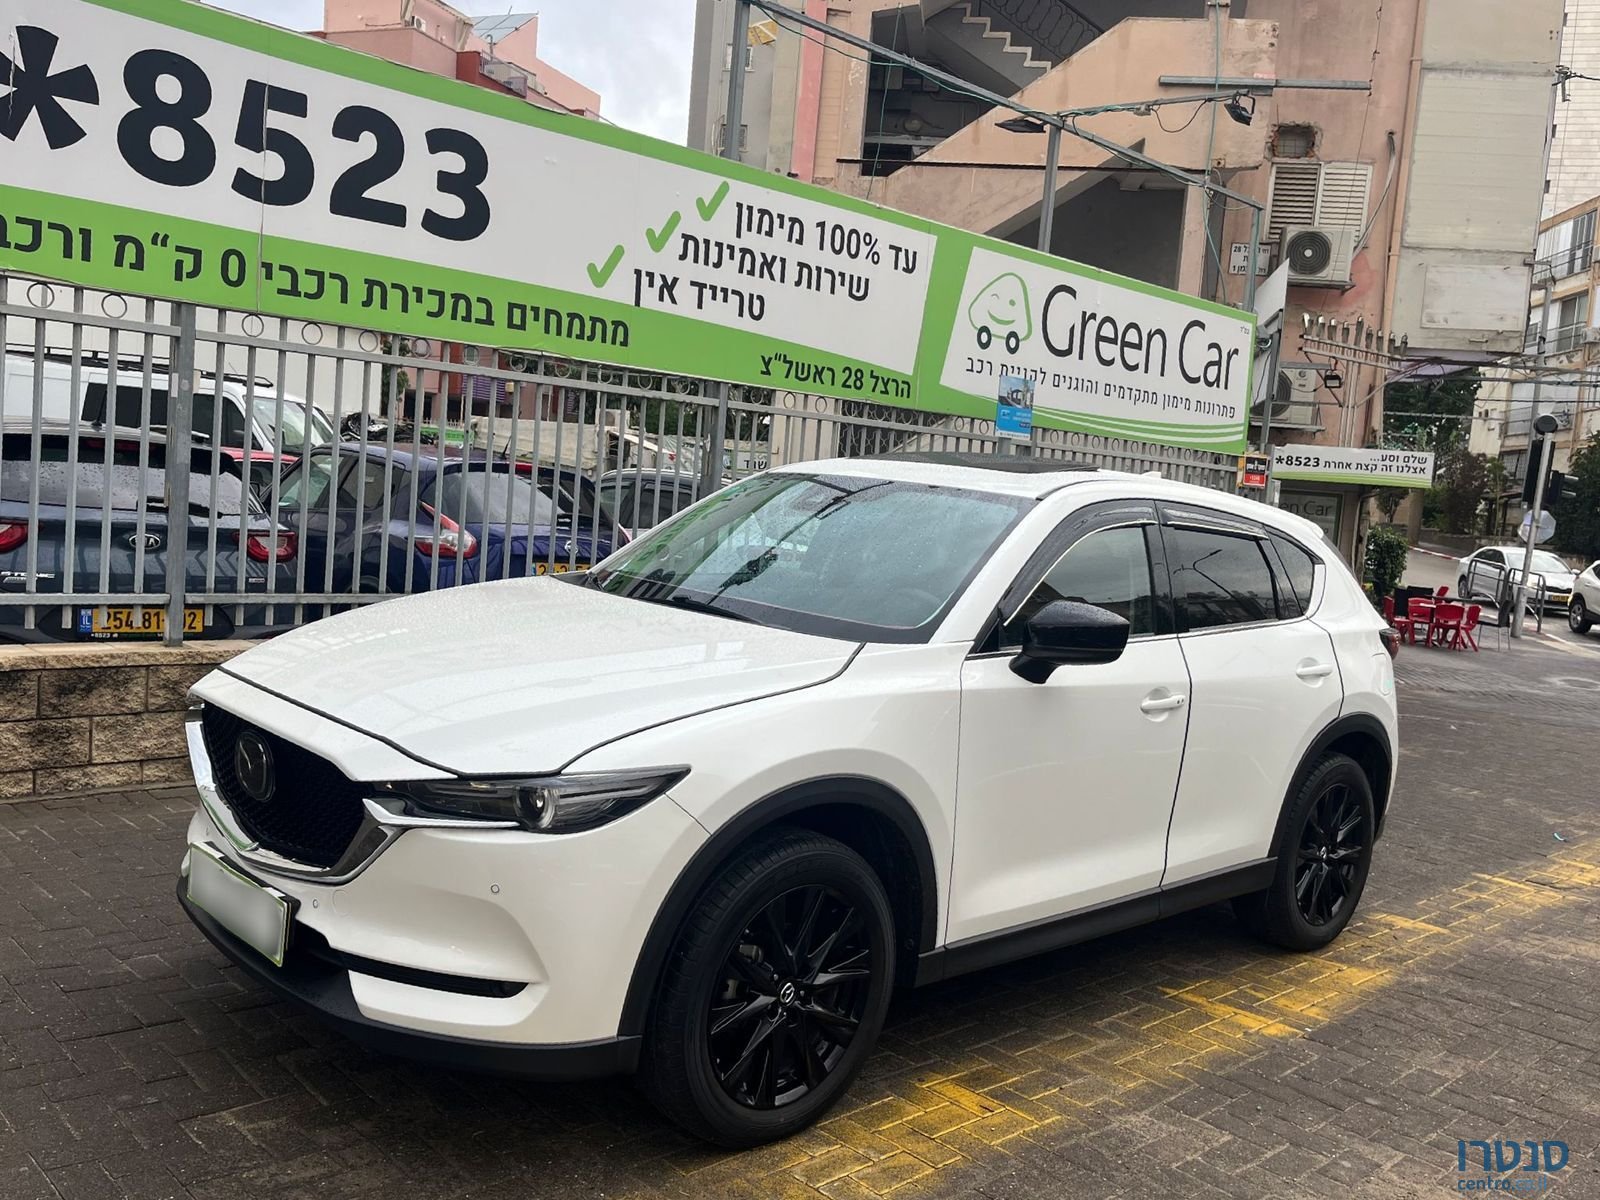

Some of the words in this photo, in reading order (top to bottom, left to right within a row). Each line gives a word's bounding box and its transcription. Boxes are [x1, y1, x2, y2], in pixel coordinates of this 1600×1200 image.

[735, 202, 805, 247] מימון
[815, 221, 880, 266] 100%
[220, 248, 247, 287] 0
[678, 233, 786, 284] ואמינות
[888, 244, 918, 274] עד
[261, 262, 349, 304] רכבי
[633, 268, 680, 308] אין
[794, 261, 870, 301] שירות
[361, 278, 495, 326] במכירת
[689, 280, 766, 321] טרייד
[506, 301, 629, 347] מתמחים
[1041, 284, 1167, 377] Green
[1178, 320, 1239, 390] Car
[841, 366, 864, 391] 28
[965, 357, 993, 376] רכב
[869, 370, 912, 399] הרצל
[1052, 373, 1099, 395] והוגנים
[1103, 382, 1157, 406] מתקדמים
[1162, 393, 1191, 411] מימון
[1194, 399, 1236, 419] פתרונות
[1323, 460, 1351, 470] אחרת
[1355, 463, 1378, 473] קצת
[1381, 464, 1392, 473] זה
[1396, 464, 1426, 474] אצלנו
[1402, 454, 1427, 464] שלם
[1303, 500, 1333, 516] Car
